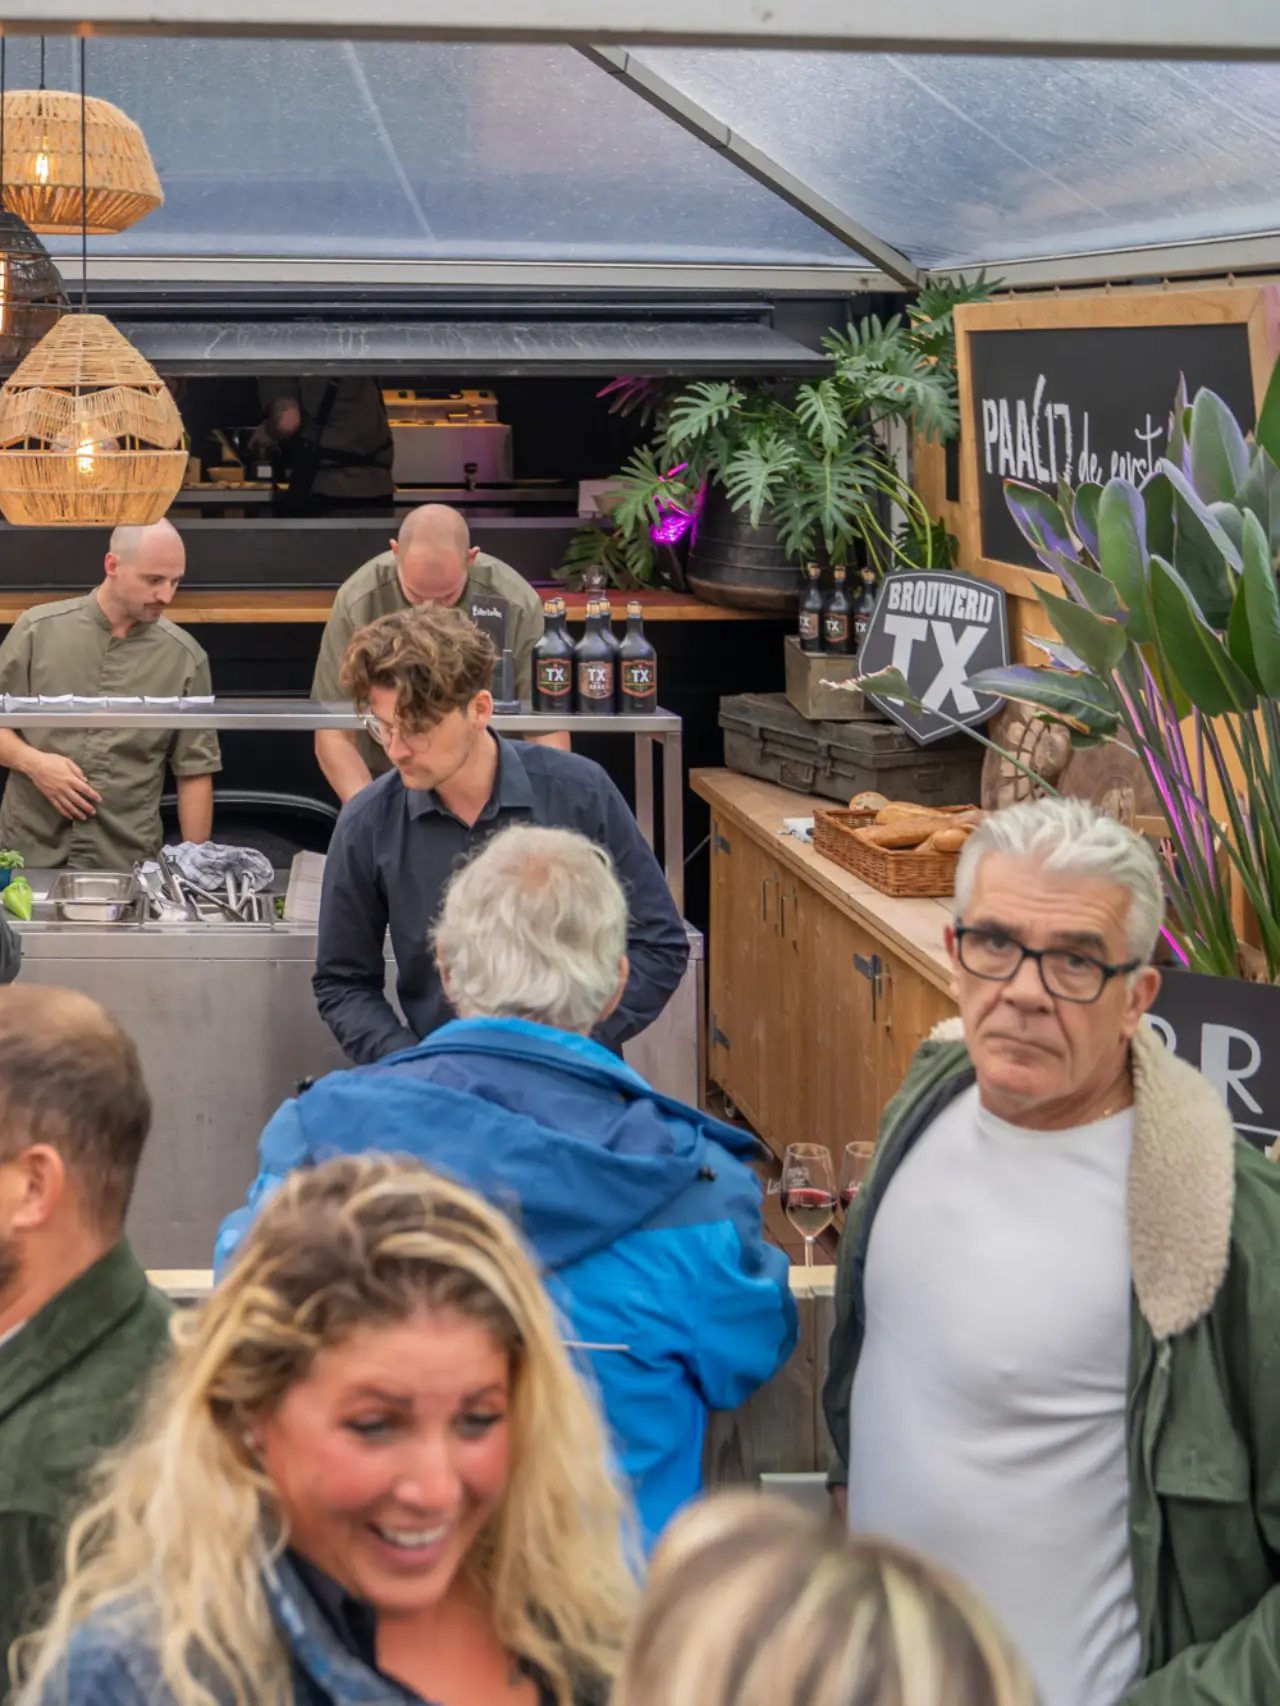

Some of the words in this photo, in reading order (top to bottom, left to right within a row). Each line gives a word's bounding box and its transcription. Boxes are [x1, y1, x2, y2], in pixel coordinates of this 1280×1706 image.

[1078, 412, 1104, 485] de
[887, 580, 995, 624] BROUWERIJ
[824, 620, 840, 632] TX
[855, 621, 867, 633] TX
[883, 614, 989, 715] TX
[545, 667, 565, 682] TX
[587, 667, 606, 682] TX
[631, 668, 650, 683] TX
